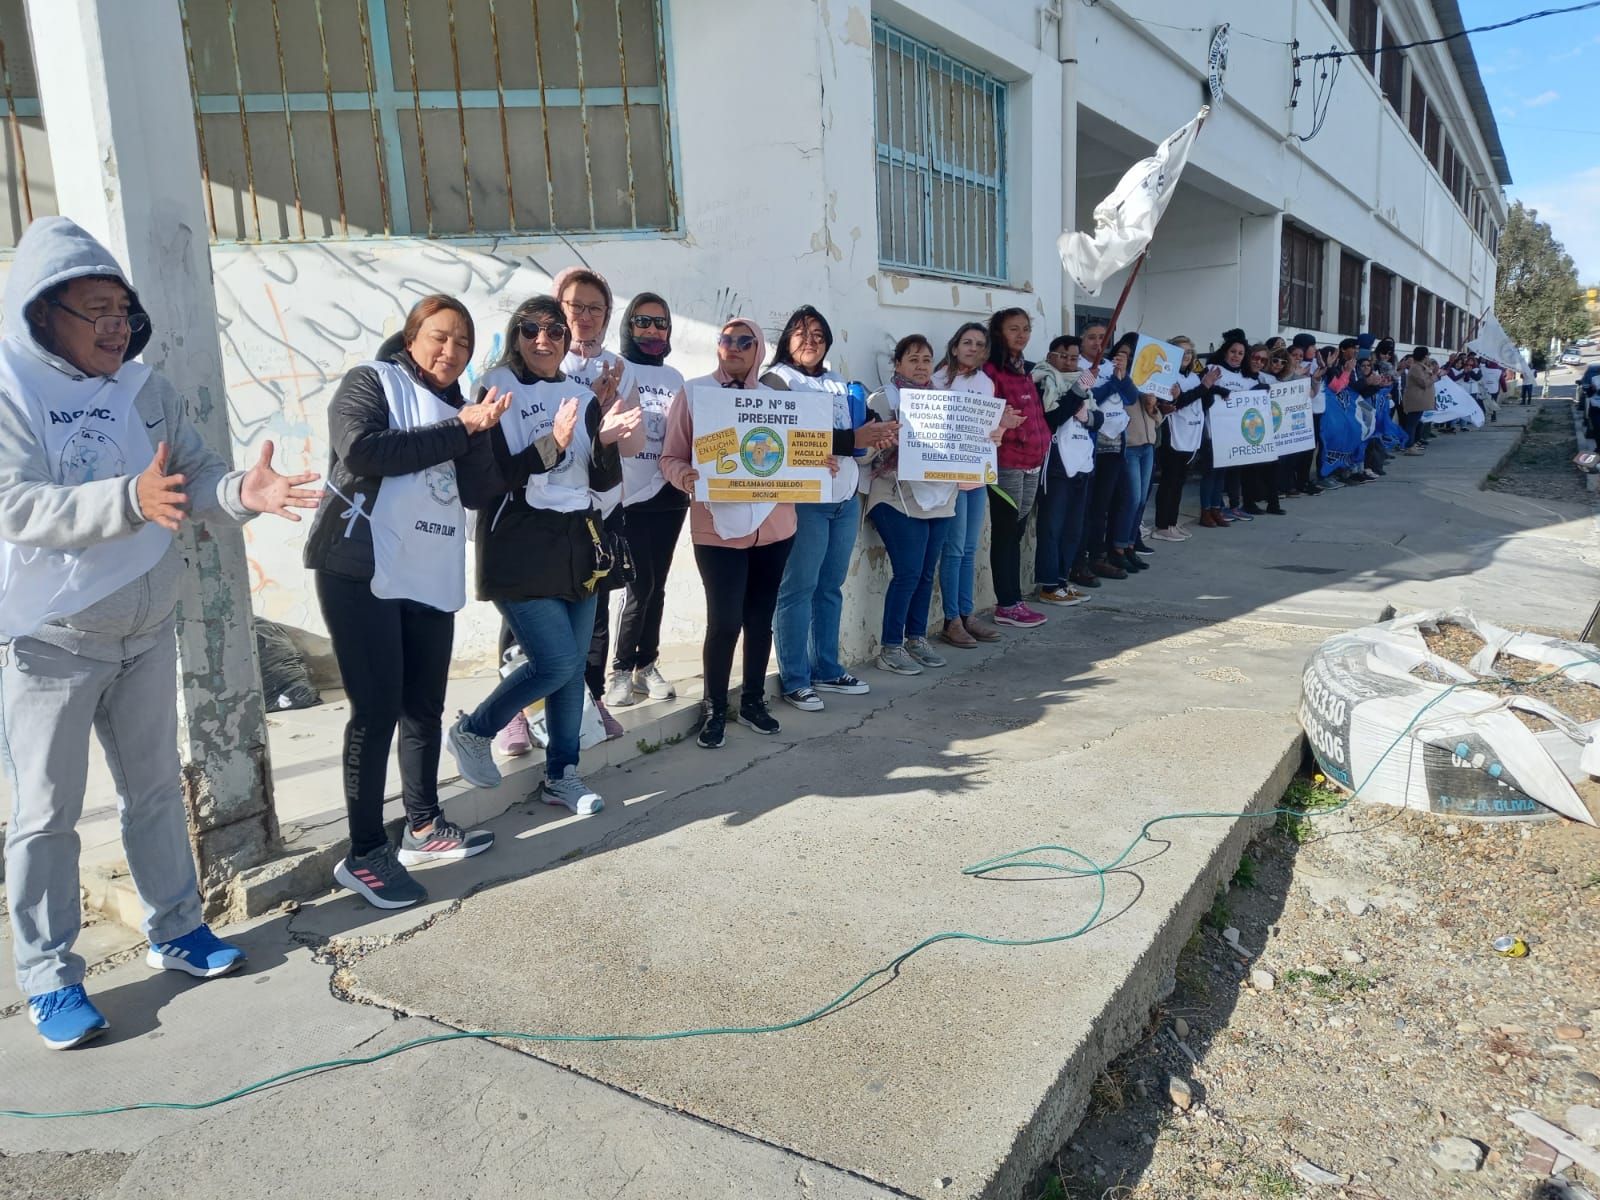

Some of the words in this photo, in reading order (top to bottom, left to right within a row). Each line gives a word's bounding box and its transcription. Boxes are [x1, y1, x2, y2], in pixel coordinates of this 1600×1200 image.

[784, 401, 796, 410] 88
[738, 412, 798, 425] ¡PRESENTE!
[414, 520, 442, 535] CALETA
[348, 743, 362, 766] DO
[346, 766, 360, 800] JUST
